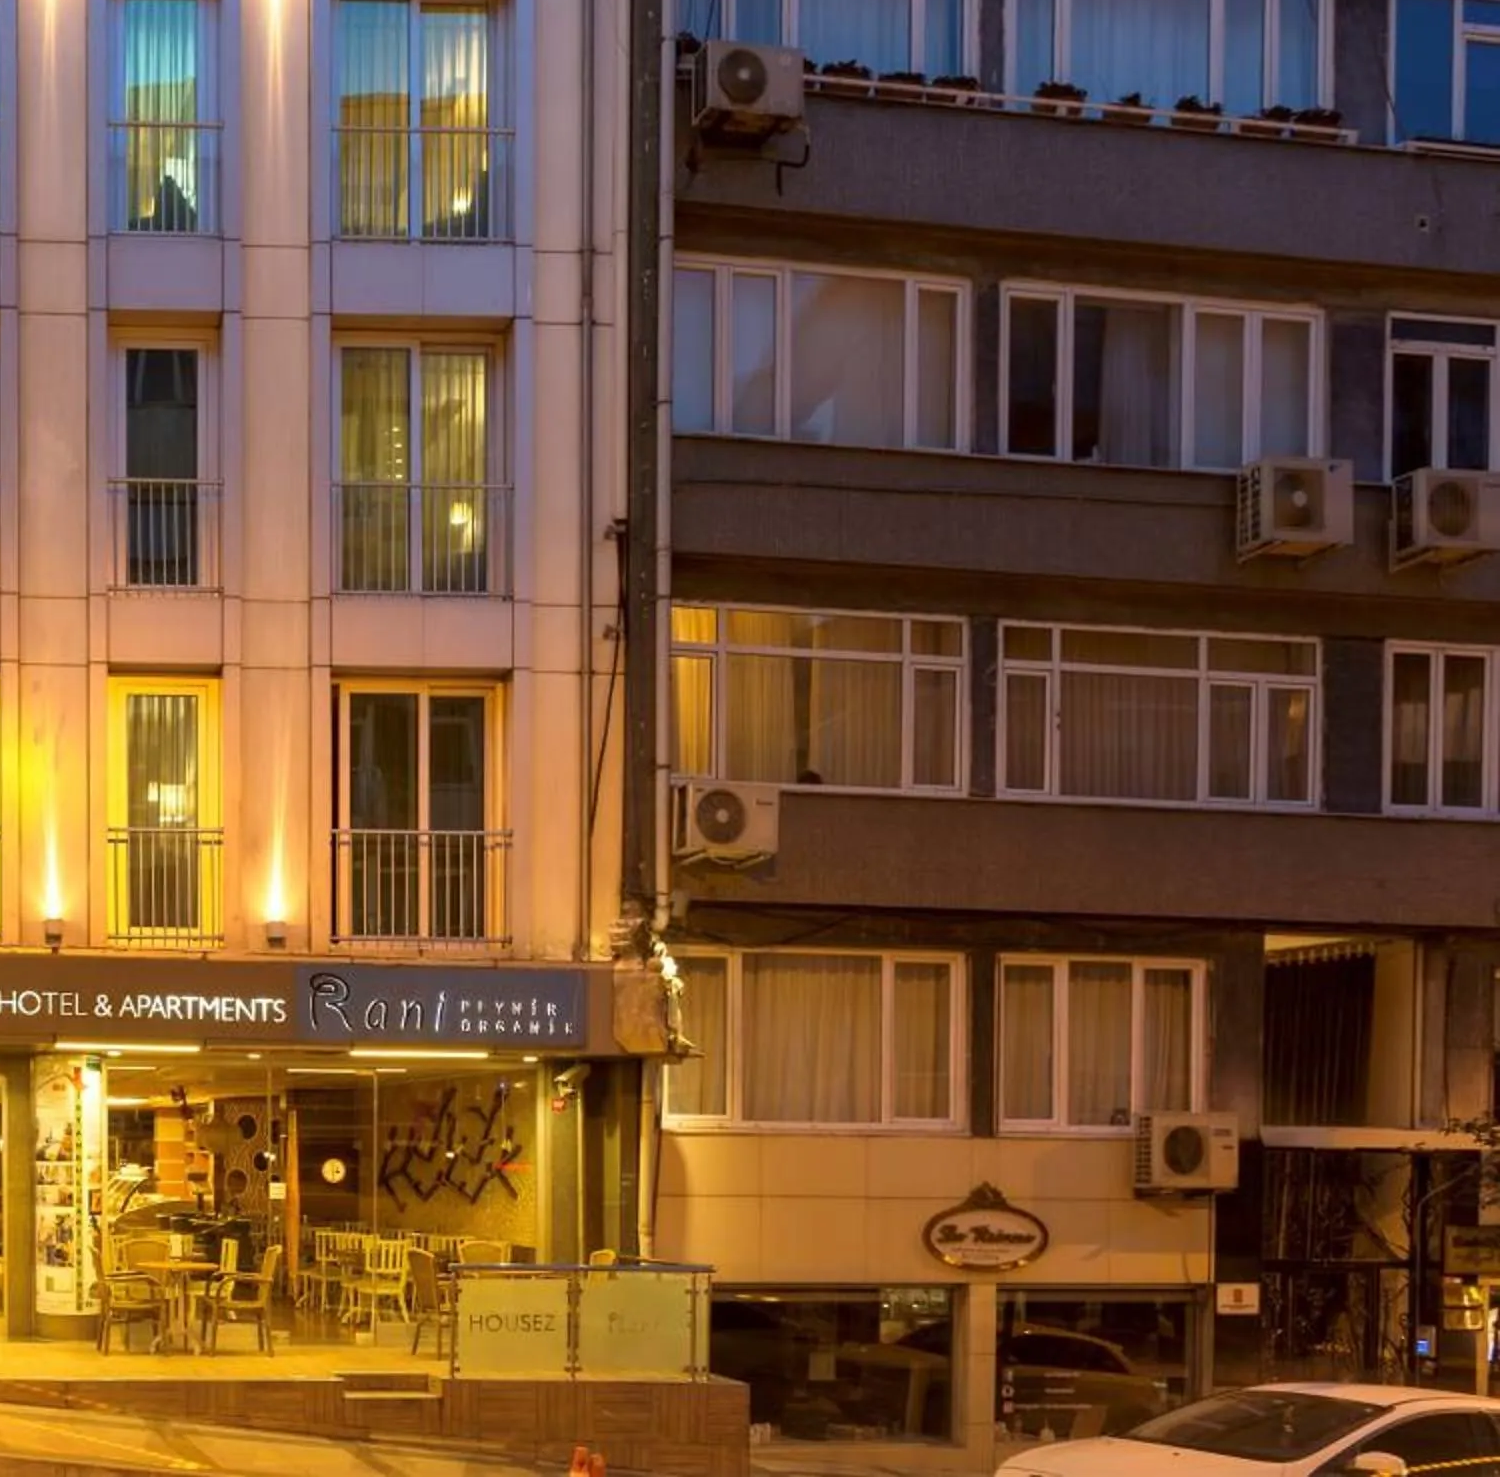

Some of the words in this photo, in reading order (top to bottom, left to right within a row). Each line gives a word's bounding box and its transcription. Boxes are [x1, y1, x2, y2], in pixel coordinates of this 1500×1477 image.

[94, 994, 113, 1018] &
[119, 995, 287, 1024] APARTMENTS
[309, 973, 447, 1032] Rani
[469, 1314, 556, 1332] HOUSEZ
